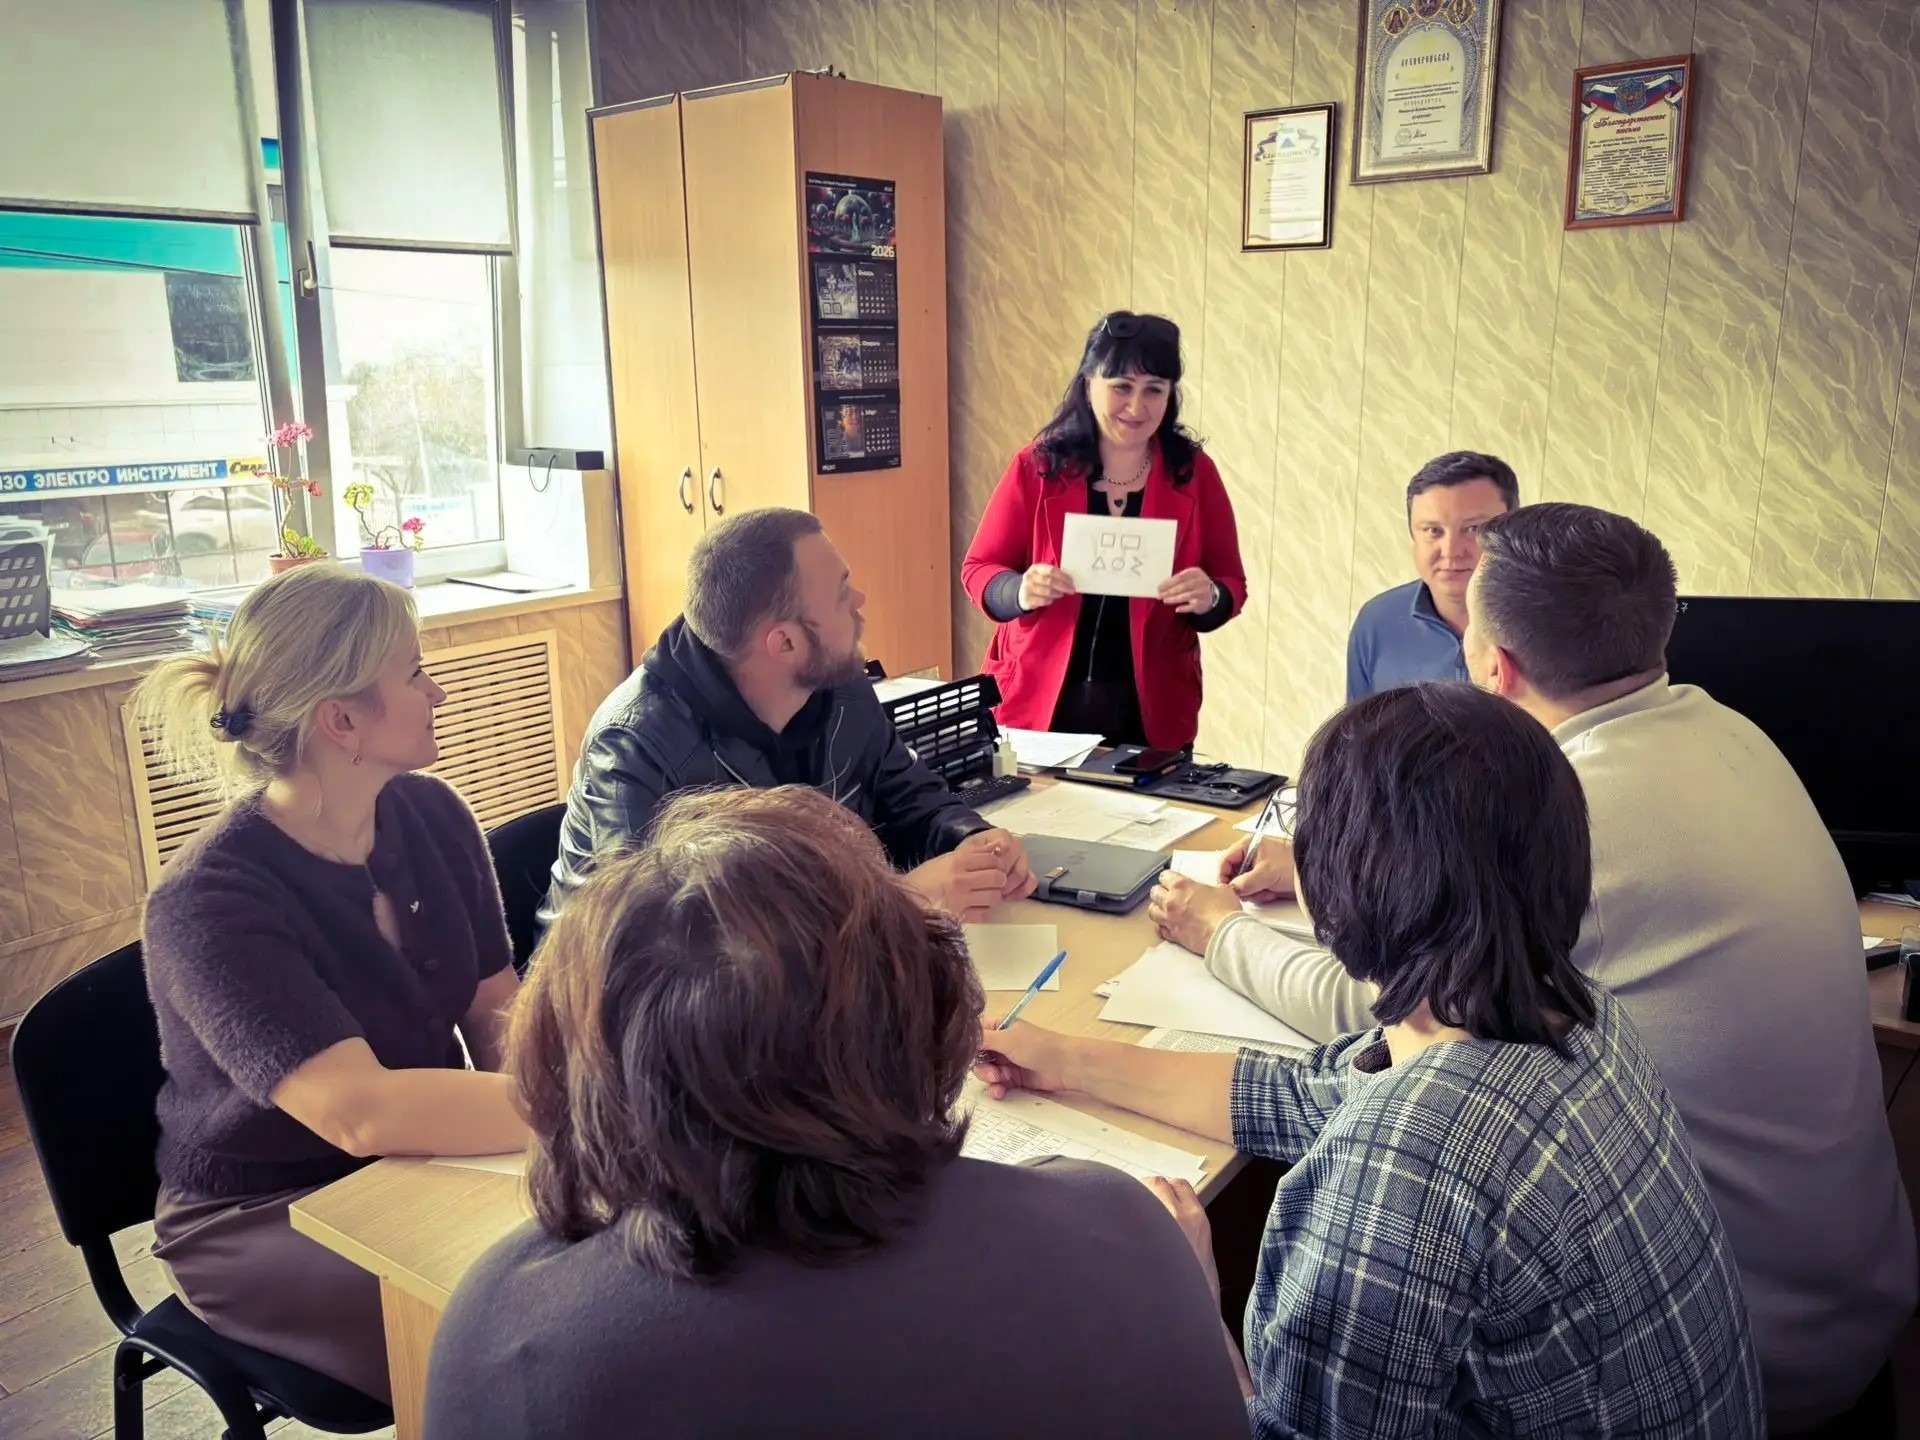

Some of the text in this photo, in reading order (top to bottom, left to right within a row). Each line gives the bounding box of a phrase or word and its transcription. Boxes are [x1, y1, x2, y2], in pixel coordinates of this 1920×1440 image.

[871, 244, 895, 258] 2026
[0, 462, 218, 491] ЗО ЭЛЕКТРО ИНСТРУМЕНТ
